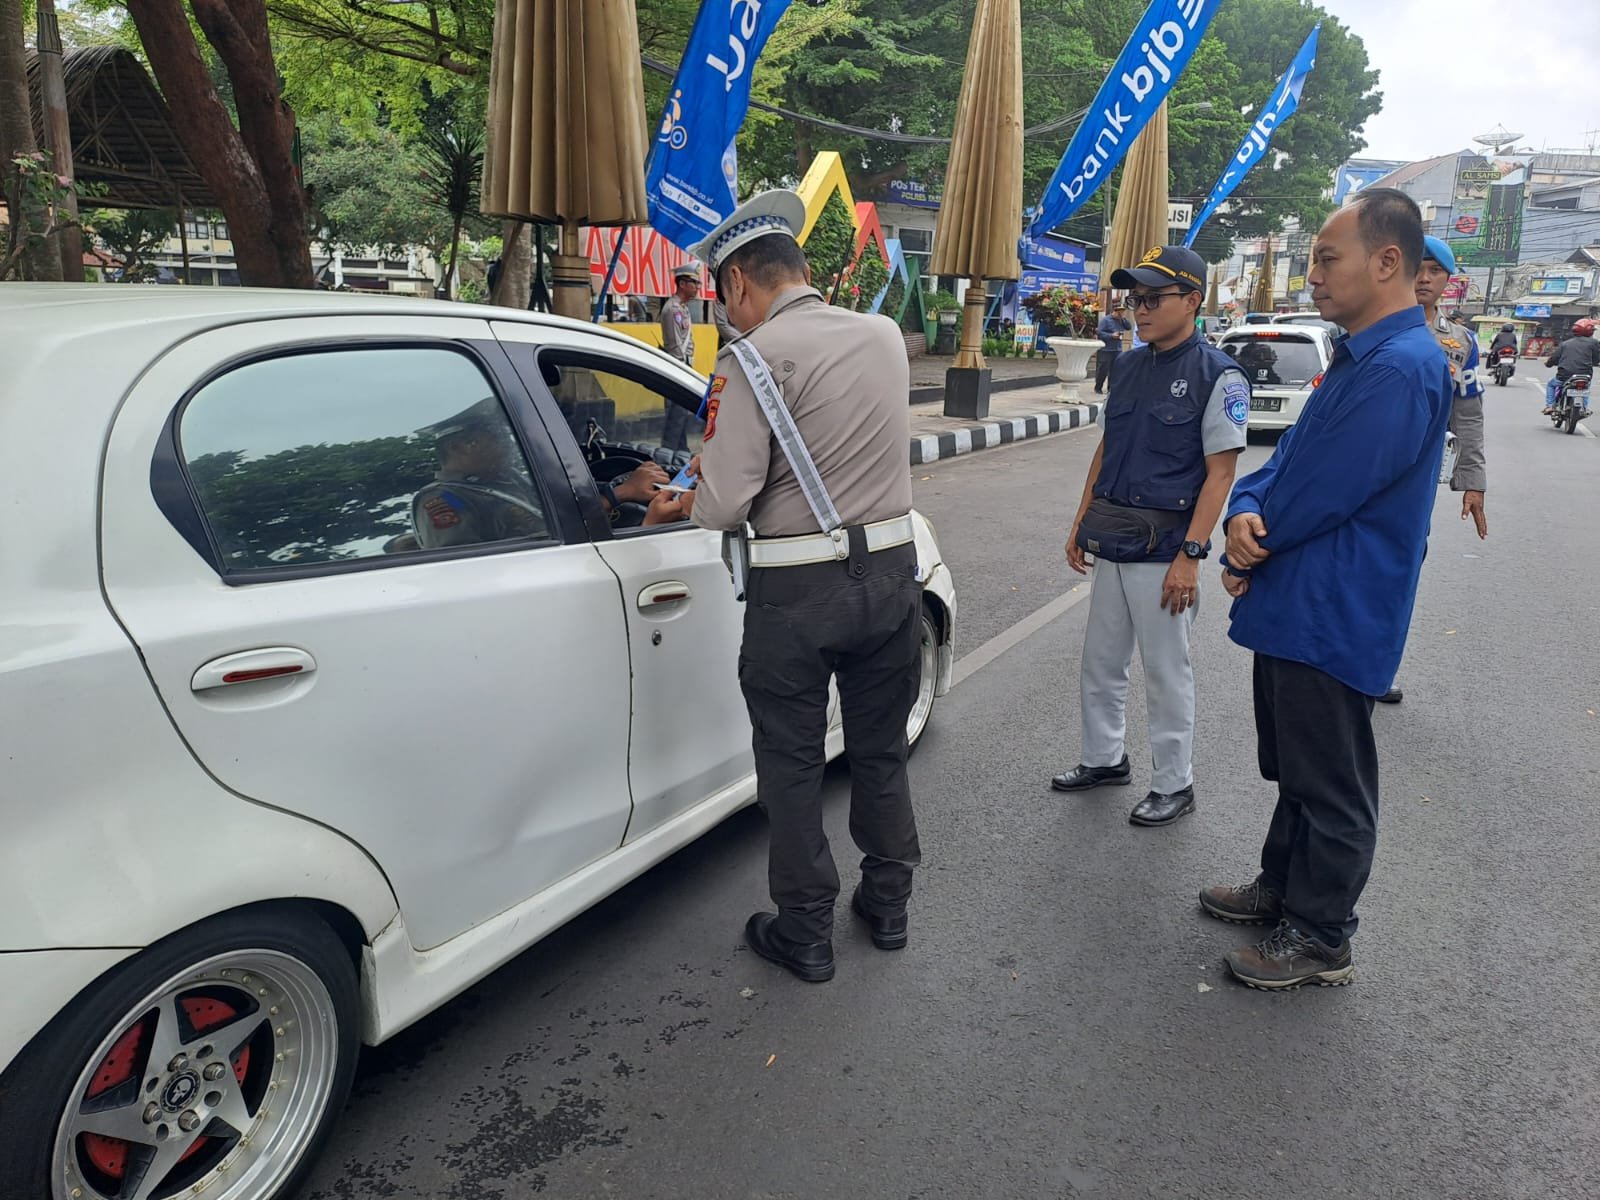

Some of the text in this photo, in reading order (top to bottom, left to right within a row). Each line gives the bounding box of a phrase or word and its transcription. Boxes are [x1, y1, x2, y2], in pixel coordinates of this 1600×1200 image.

[1060, 101, 1132, 203] bank
[1121, 21, 1184, 103] bjb
[890, 180, 908, 190] POS
